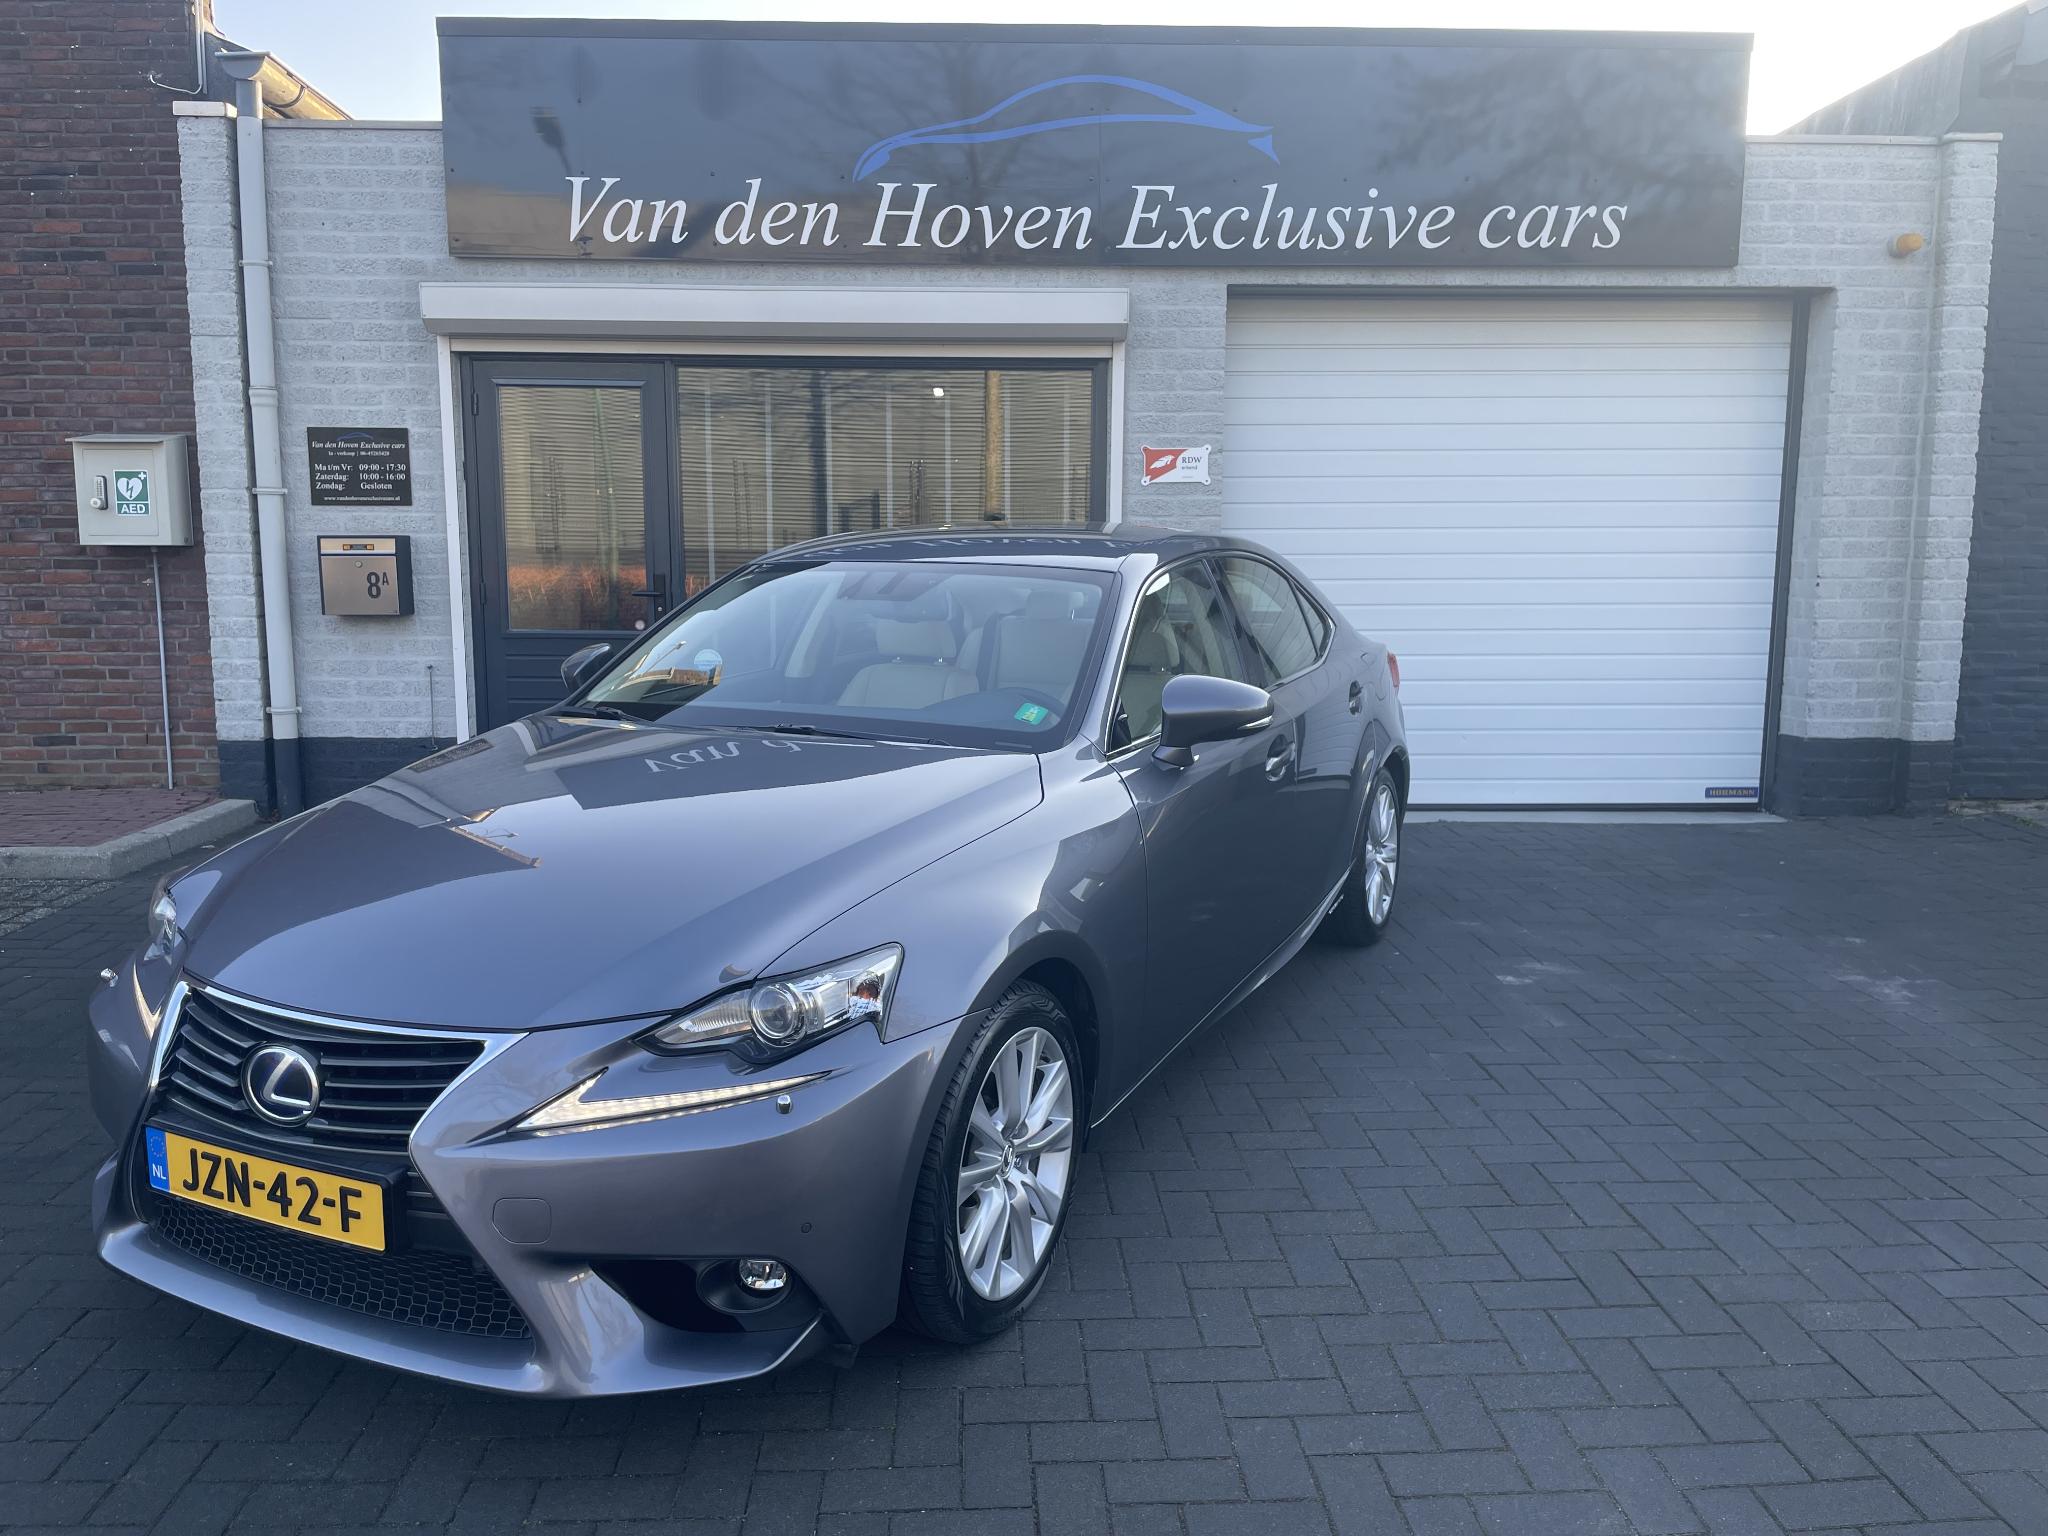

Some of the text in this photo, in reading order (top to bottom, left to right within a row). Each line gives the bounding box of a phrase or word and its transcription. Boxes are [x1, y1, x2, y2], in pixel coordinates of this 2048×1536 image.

[565, 176, 1628, 250] Van den Hoven Exclusive cars
[1181, 456, 1202, 464] RDW
[315, 473, 349, 482] Zaterdag:
[315, 482, 393, 491] Zondag: Gesloten
[120, 504, 145, 514] AED
[152, 1163, 167, 1181] NL
[182, 1147, 362, 1232] JZN-42-F
